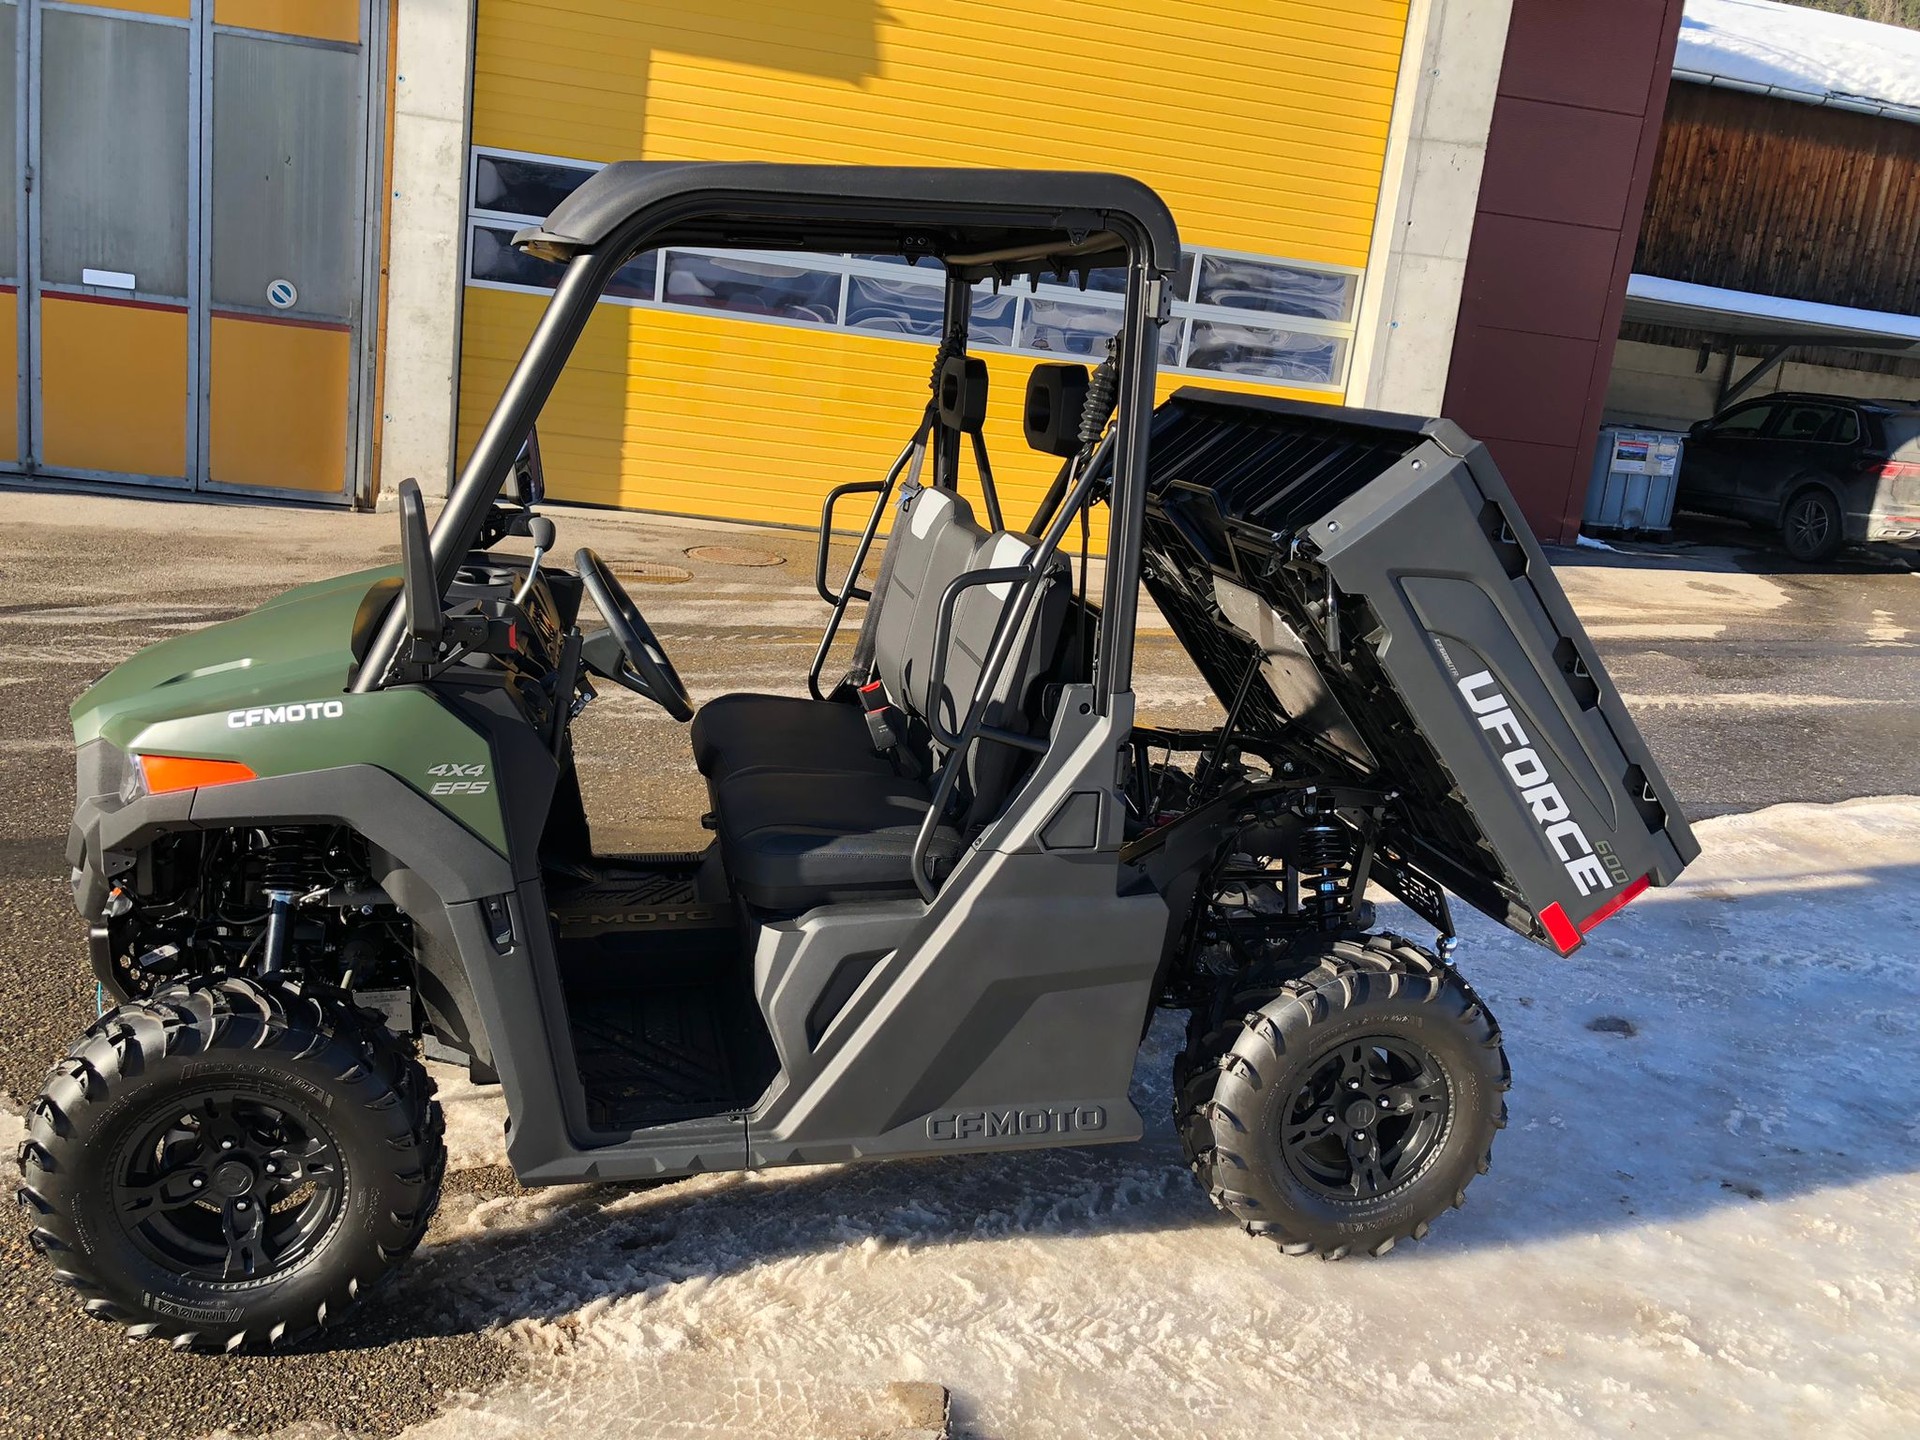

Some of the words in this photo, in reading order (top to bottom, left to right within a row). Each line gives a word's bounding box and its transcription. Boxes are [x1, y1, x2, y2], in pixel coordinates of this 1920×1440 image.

[227, 700, 344, 729] CFMOTO
[426, 763, 487, 778] 4X4
[1457, 670, 1613, 896] UFORCE
[430, 781, 490, 795] EPS
[1594, 840, 1631, 884] 600
[925, 1104, 1107, 1141] CFMOTO
